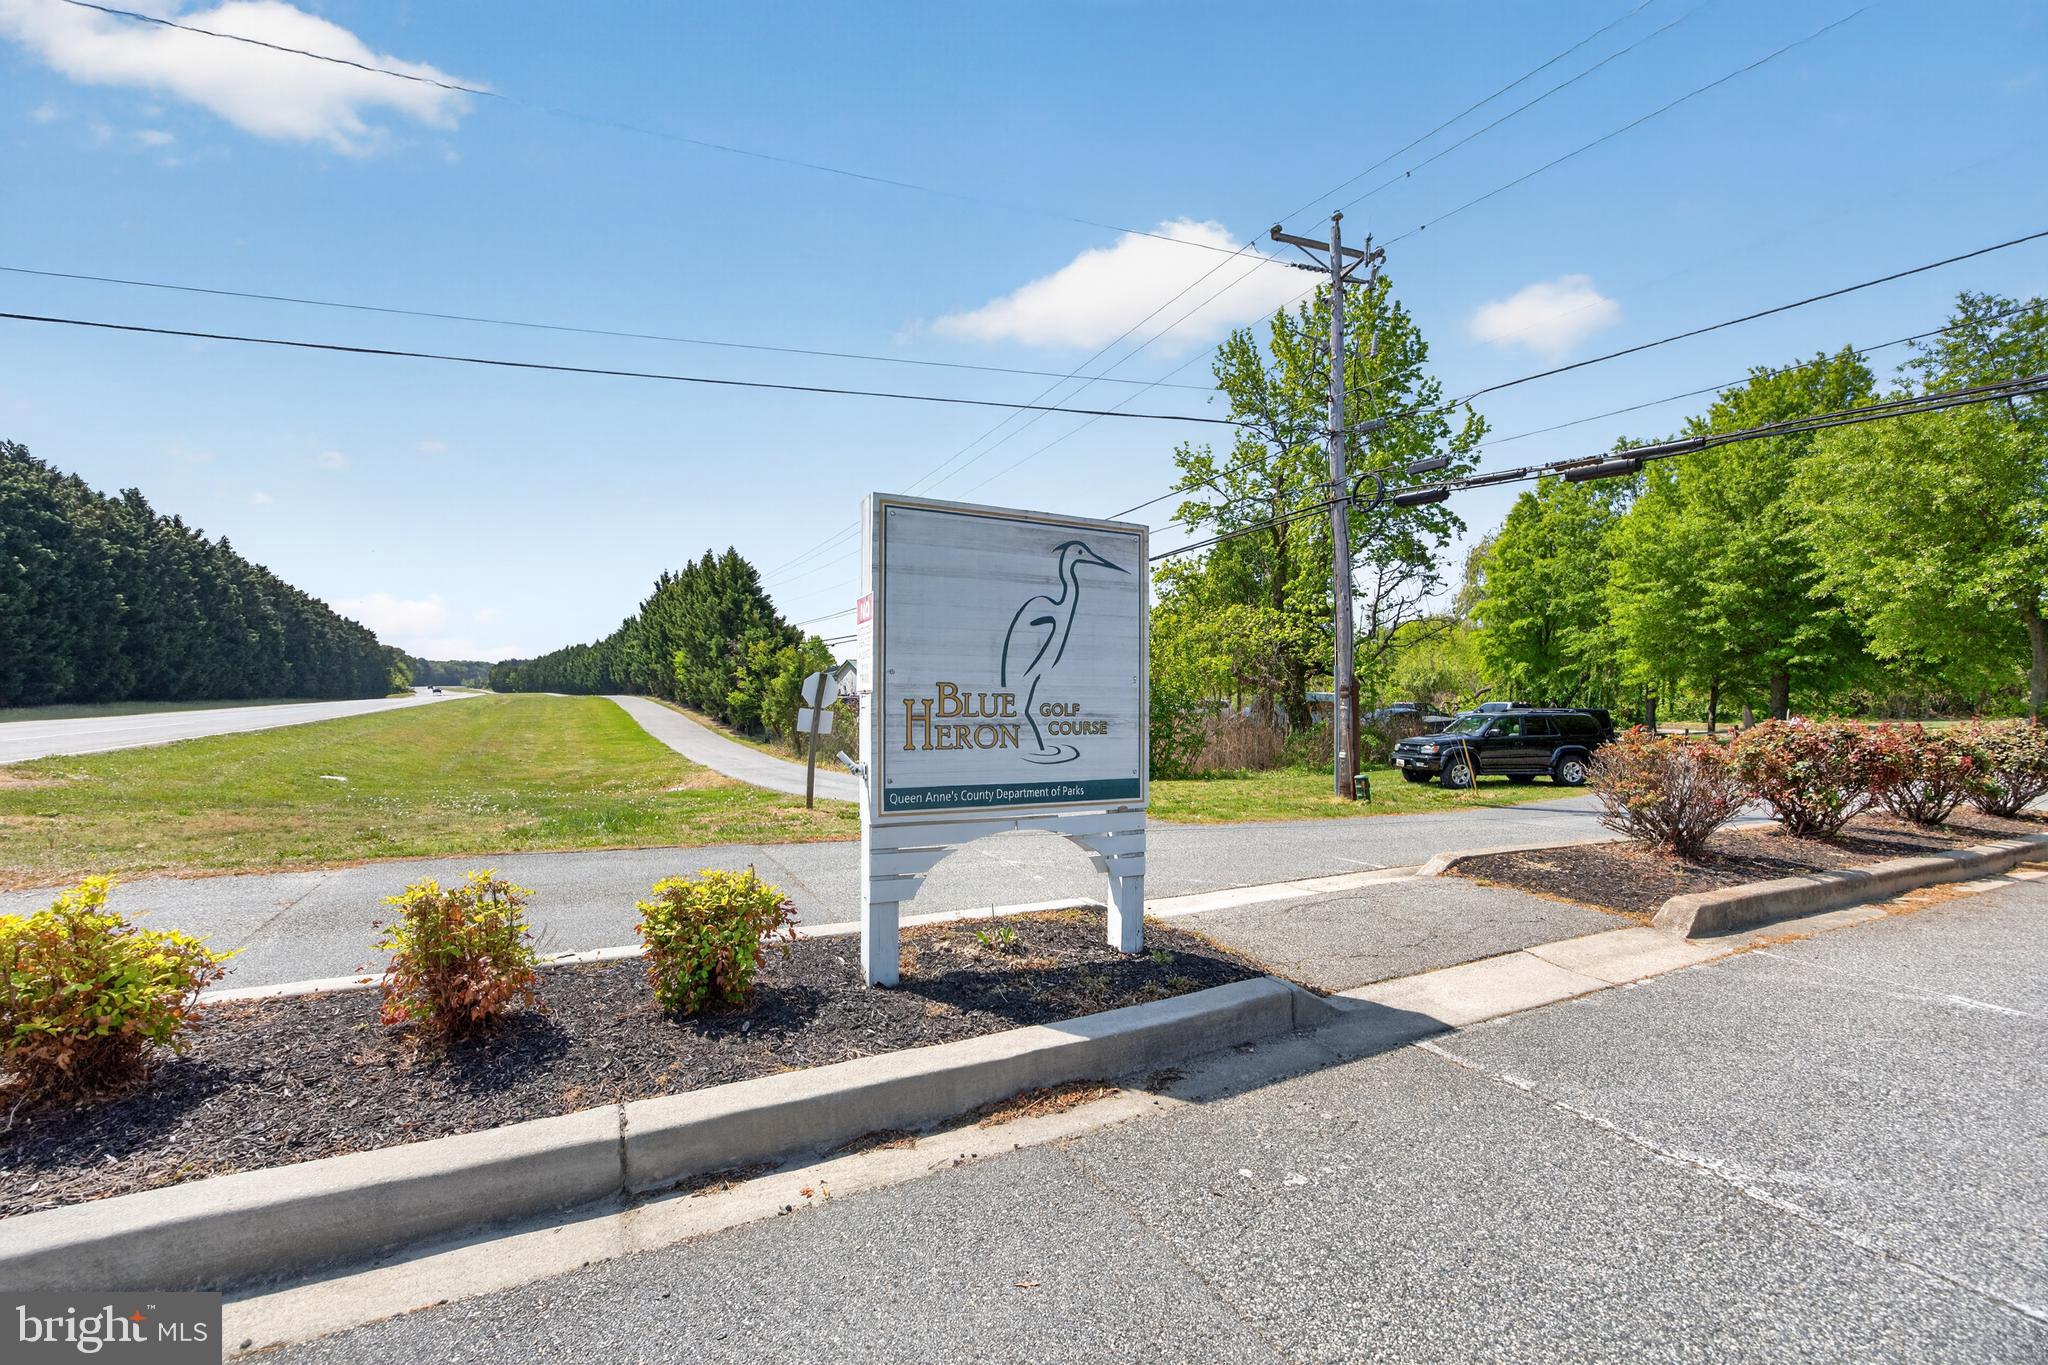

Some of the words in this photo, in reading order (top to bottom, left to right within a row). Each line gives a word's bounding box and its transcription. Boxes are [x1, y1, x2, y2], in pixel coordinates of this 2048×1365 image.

[936, 682, 1017, 718] BLUE
[1039, 702, 1081, 717] GOLF
[903, 699, 1020, 751] HERON
[1047, 720, 1108, 736] COURSE
[889, 793, 923, 805] Queen
[925, 790, 958, 802] Anne's
[960, 789, 994, 802] County
[996, 786, 1049, 801] Department
[1050, 785, 1061, 797] of
[1062, 785, 1085, 797] Parks
